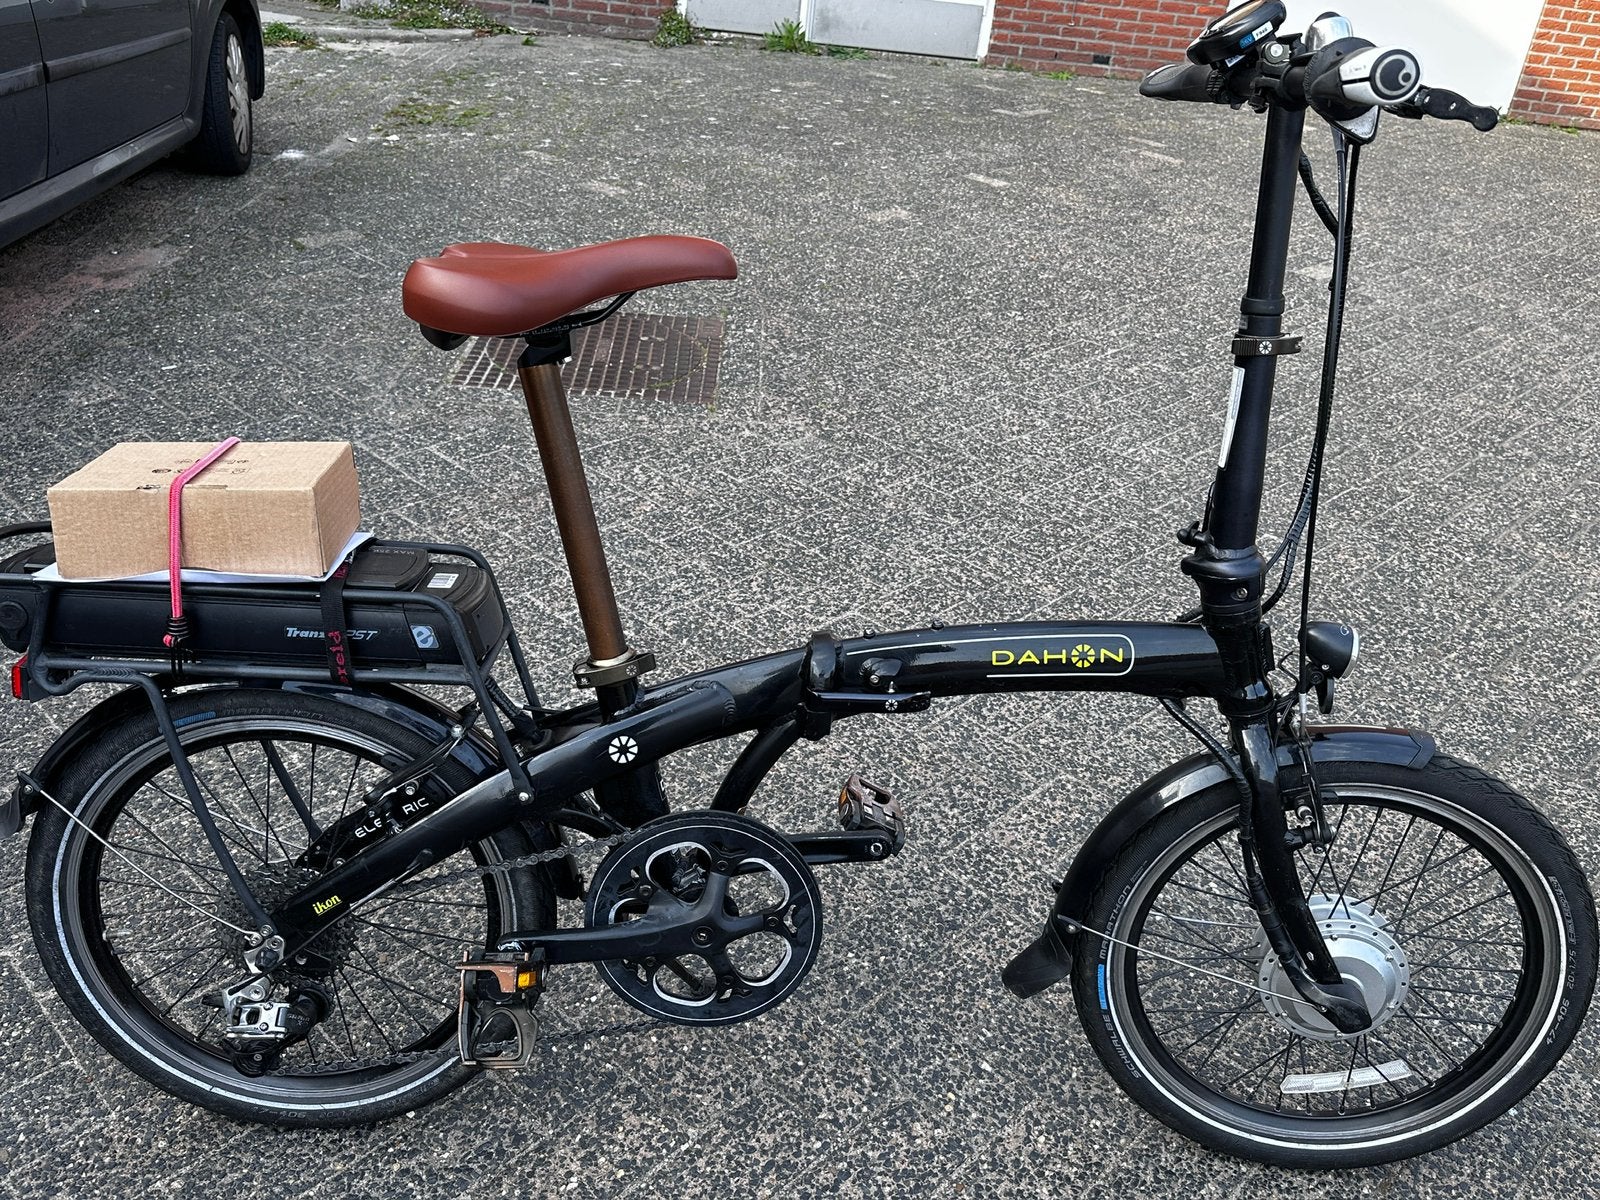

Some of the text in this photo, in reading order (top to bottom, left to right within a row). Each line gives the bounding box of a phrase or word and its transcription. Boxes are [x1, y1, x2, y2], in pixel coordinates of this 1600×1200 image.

[992, 643, 1124, 668] DAHON
[354, 797, 430, 838] ELERIC
[312, 895, 342, 916] ikon
[1546, 998, 1570, 1045] 47-406
[1102, 1014, 1142, 1079] SCHWALBE
